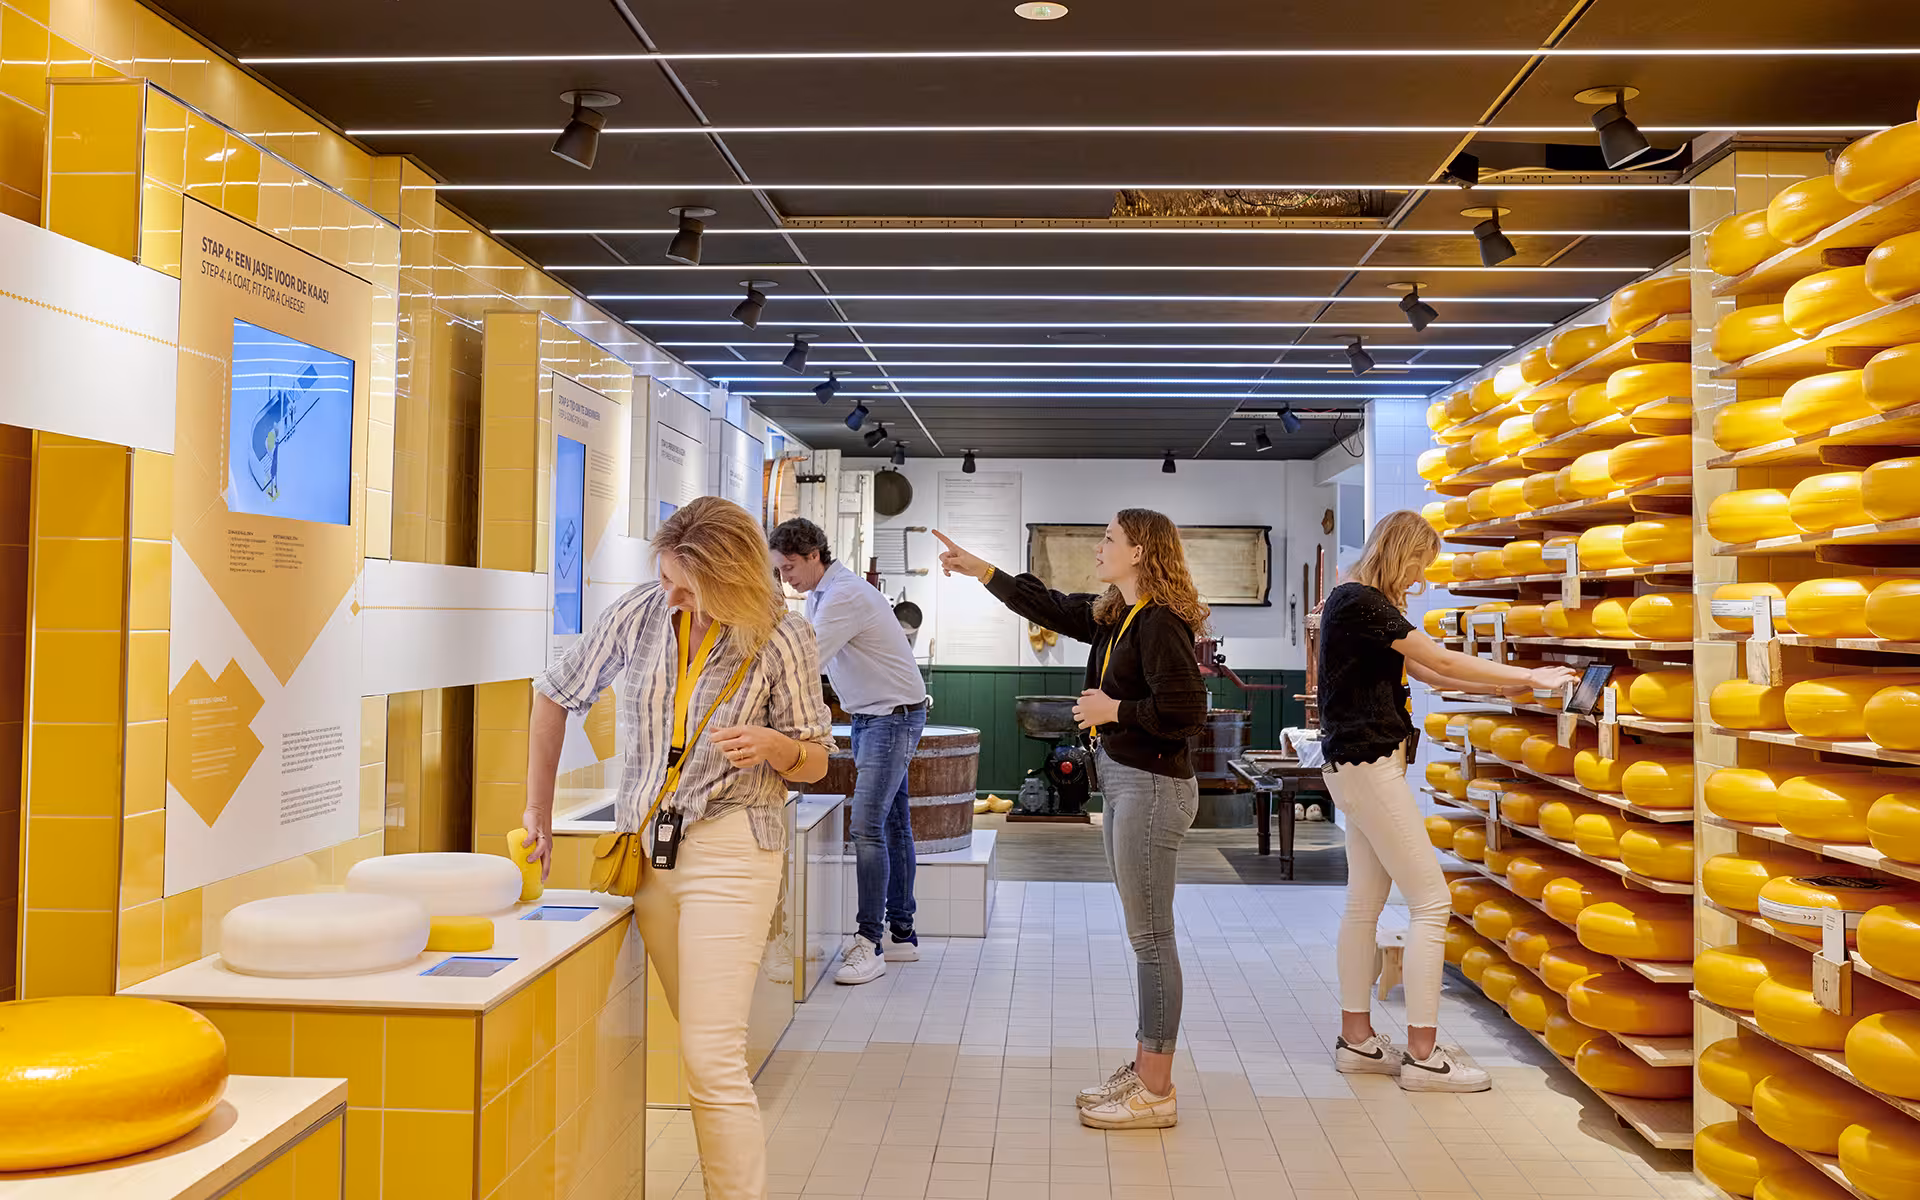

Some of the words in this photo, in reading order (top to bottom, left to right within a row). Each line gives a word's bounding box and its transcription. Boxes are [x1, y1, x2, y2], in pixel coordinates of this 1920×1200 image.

[201, 259, 219, 279] STEP
[219, 268, 227, 281] 4:
[226, 271, 232, 283] A
[232, 273, 251, 295] COAT,
[252, 280, 262, 297] FIT
[262, 283, 276, 303] FOR
[281, 292, 306, 314] CHEESE!
[202, 236, 224, 258] STAP
[225, 247, 234, 262] 4:
[235, 250, 251, 271] EEN
[252, 258, 273, 282] JASJE
[274, 267, 296, 290] VOOR
[297, 278, 307, 295] DE
[307, 282, 329, 304] KAAS!
